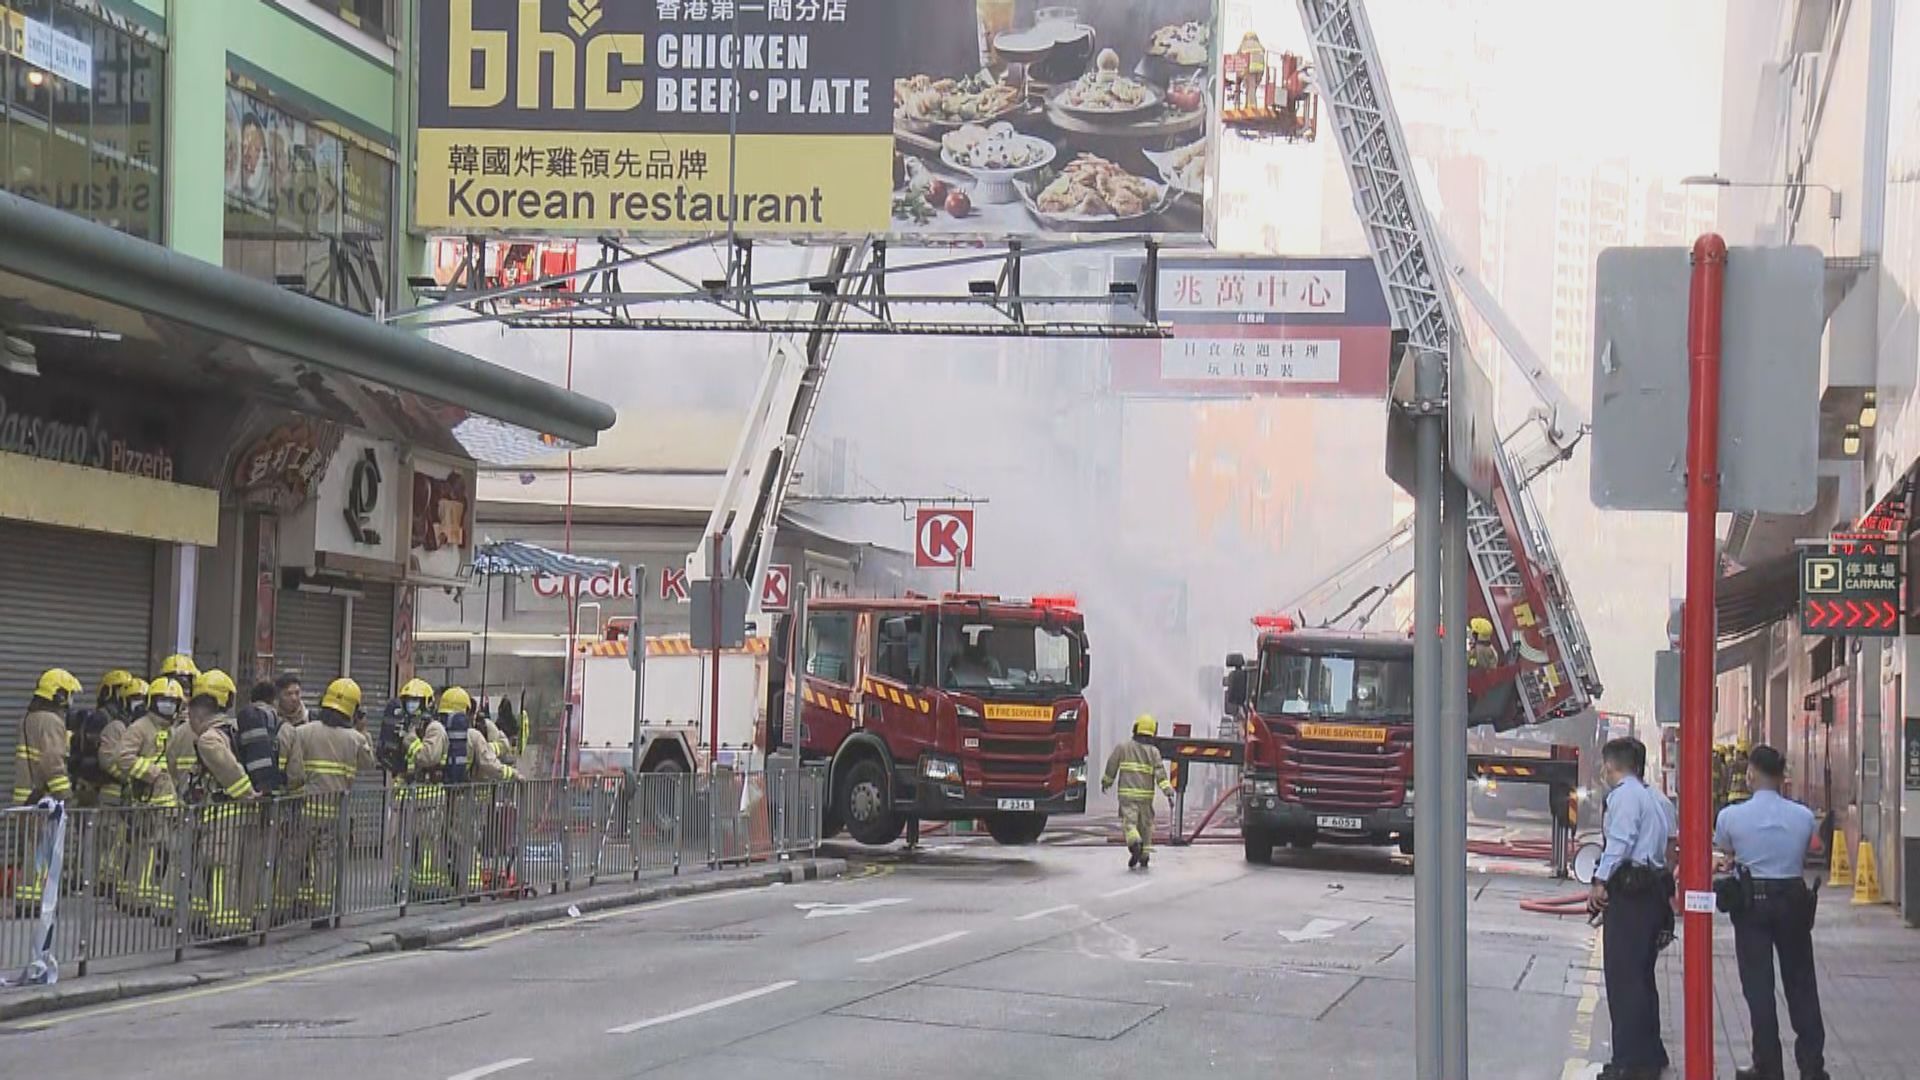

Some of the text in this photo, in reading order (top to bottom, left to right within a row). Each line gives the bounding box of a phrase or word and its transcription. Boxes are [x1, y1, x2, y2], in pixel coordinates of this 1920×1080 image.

[448, 0, 645, 112] bhc
[656, 34, 808, 70] CHICKEN
[447, 143, 709, 181] 韓國炸雞領先品牌
[448, 179, 823, 224] Korean restaurant
[1174, 274, 1331, 308] 兆萬中心
[111, 437, 173, 483] Pizzeria
[929, 519, 963, 557] K
[1813, 563, 1836, 588] P
[1844, 580, 1896, 590] CARPARK
[1846, 561, 1896, 578] 停車場
[1313, 726, 1330, 737] FIRE
[1333, 728, 1373, 739] SERVICES
